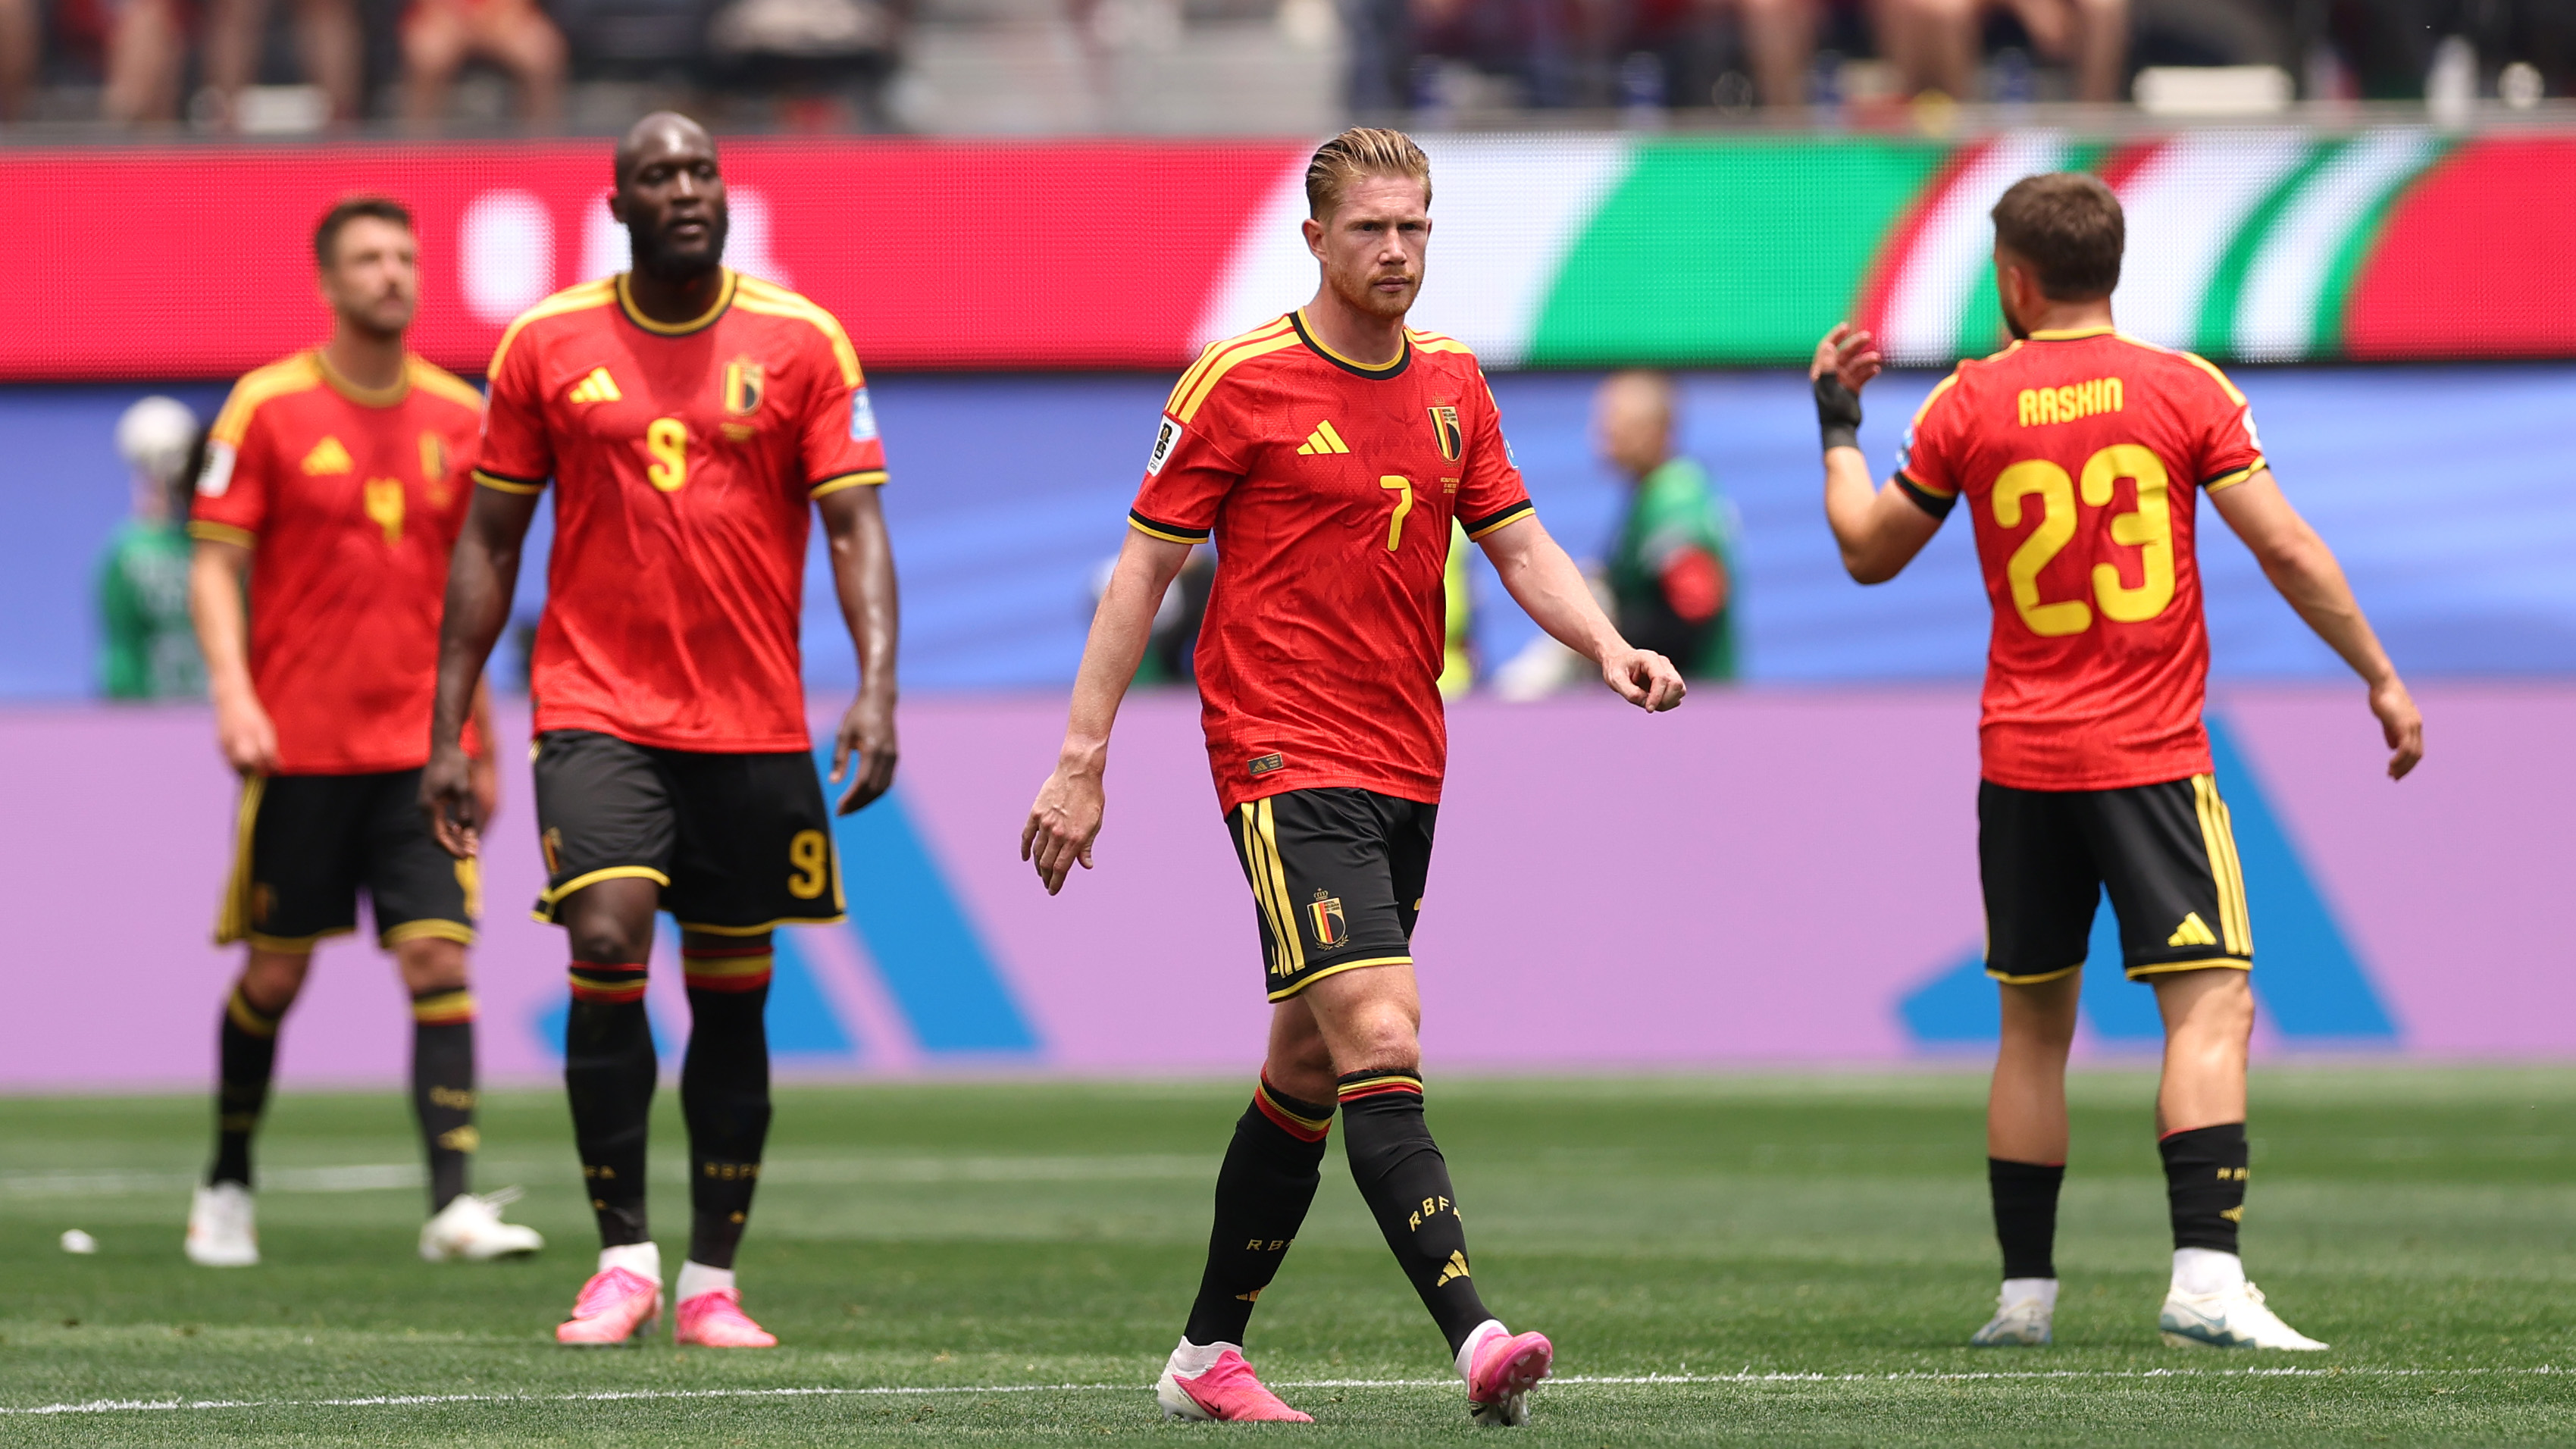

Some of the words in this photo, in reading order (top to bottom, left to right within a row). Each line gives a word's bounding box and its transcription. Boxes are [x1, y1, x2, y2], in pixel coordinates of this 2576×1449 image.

[2018, 377, 2124, 427] RASKIN
[646, 417, 687, 492] 9
[364, 477, 405, 546] 4
[1379, 475, 1413, 552] 7
[1991, 443, 2176, 637] 23
[787, 829, 828, 900] 9
